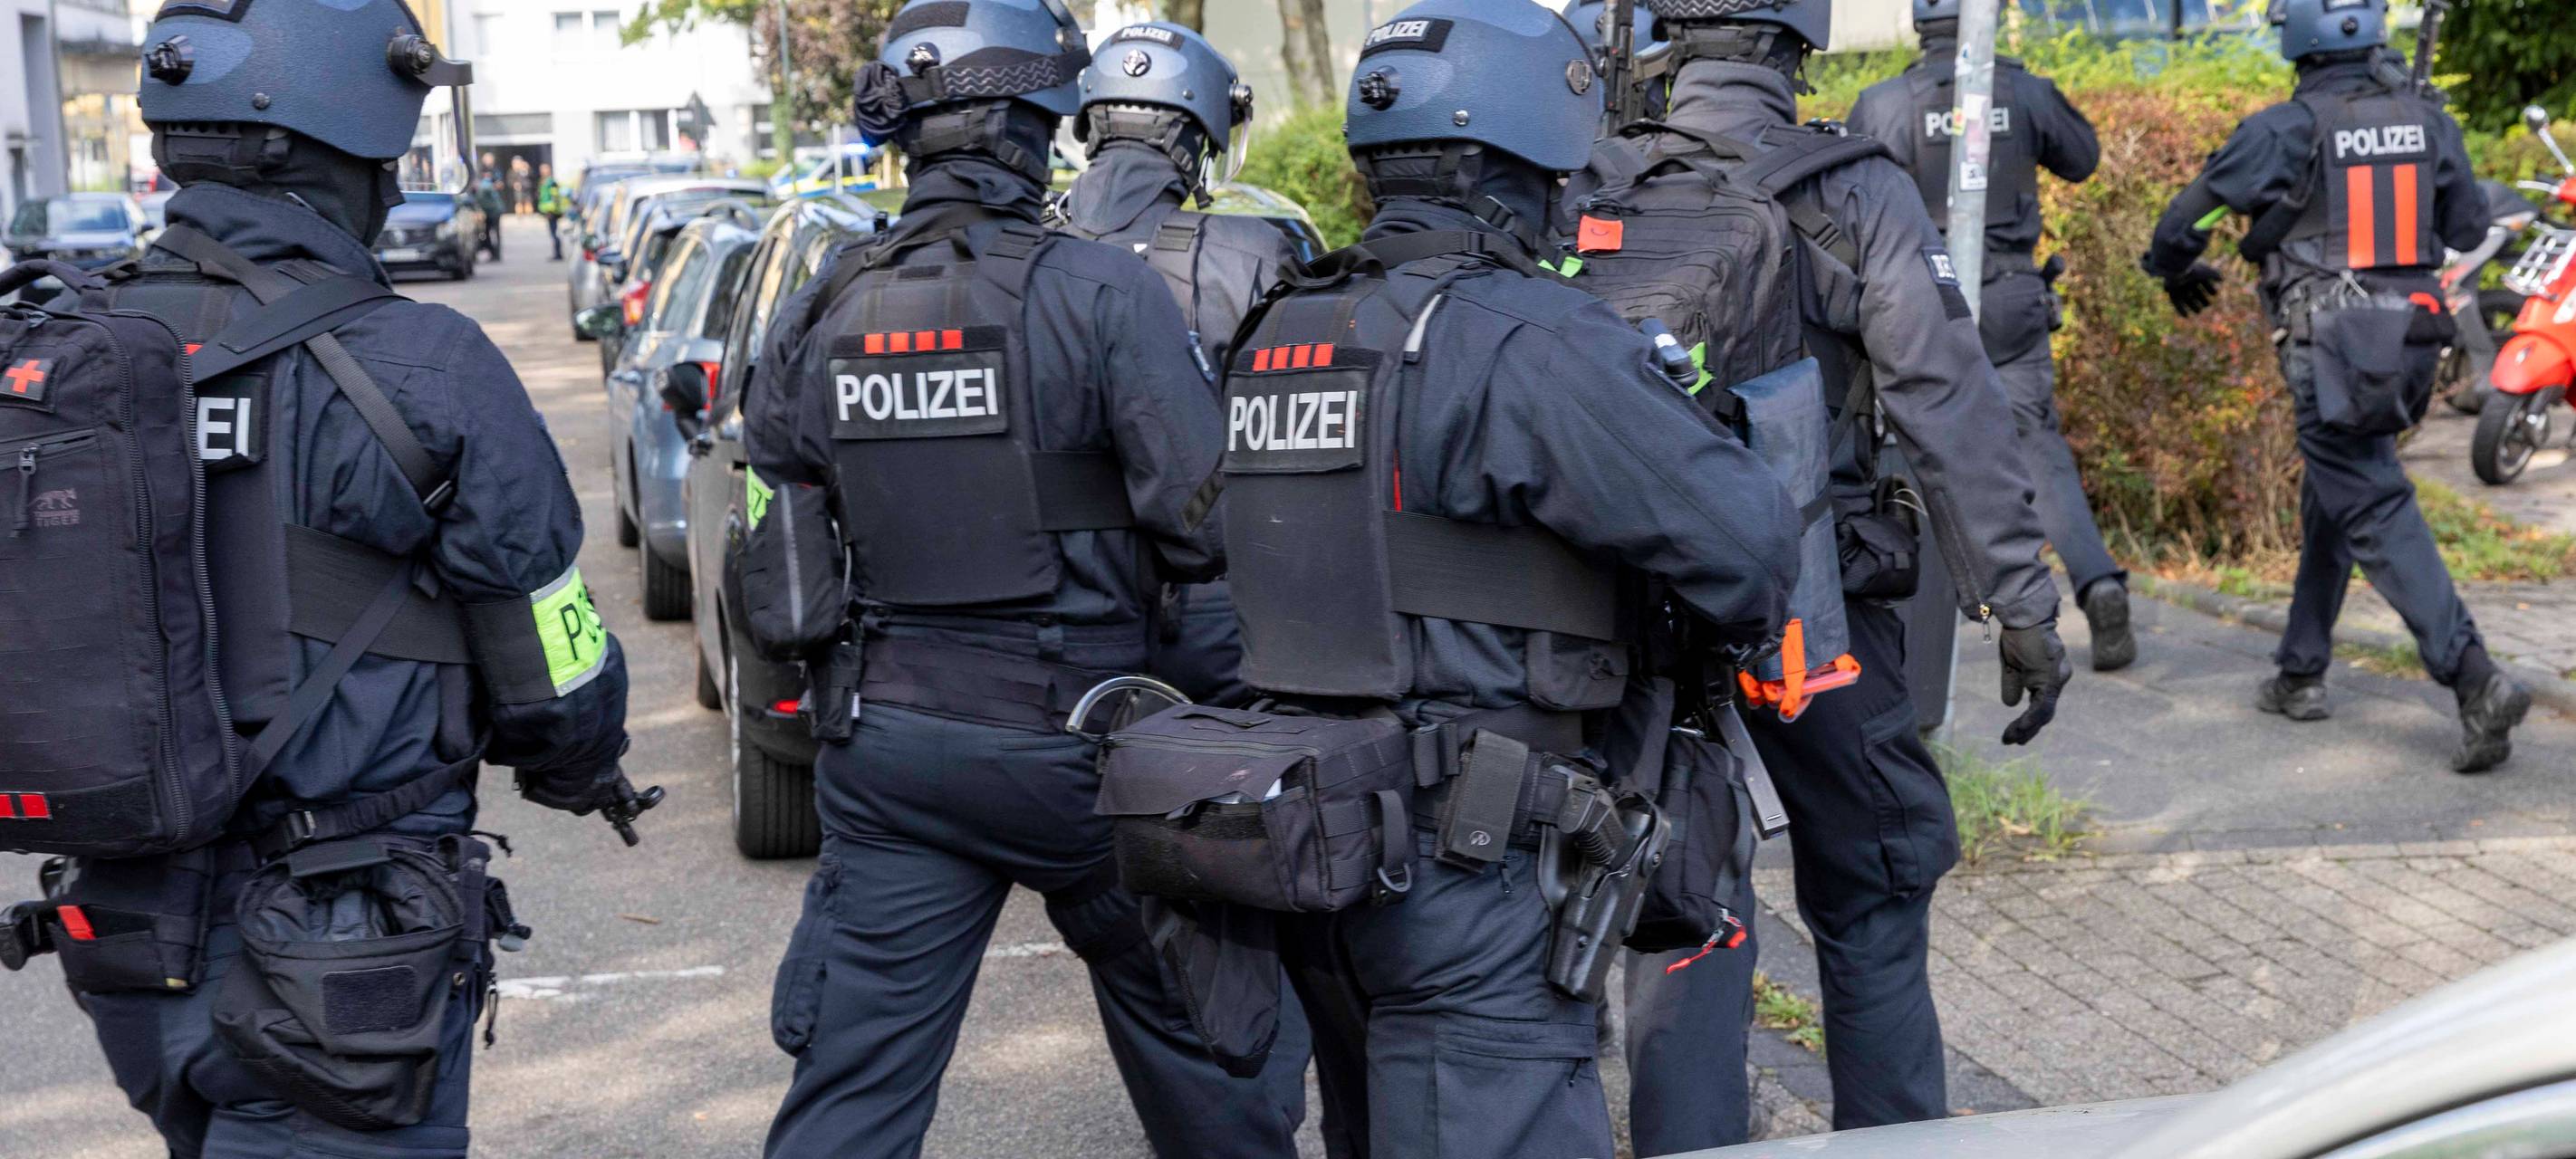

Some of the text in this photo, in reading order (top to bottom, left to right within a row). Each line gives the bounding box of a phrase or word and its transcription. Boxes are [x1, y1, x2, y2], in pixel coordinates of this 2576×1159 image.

[1121, 26, 1172, 42] POLIZEI
[1925, 107, 2010, 138] POEI
[2334, 124, 2426, 158] POLIZEI
[835, 368, 999, 421] POLIZEI
[1228, 390, 1358, 452] POLIZEI
